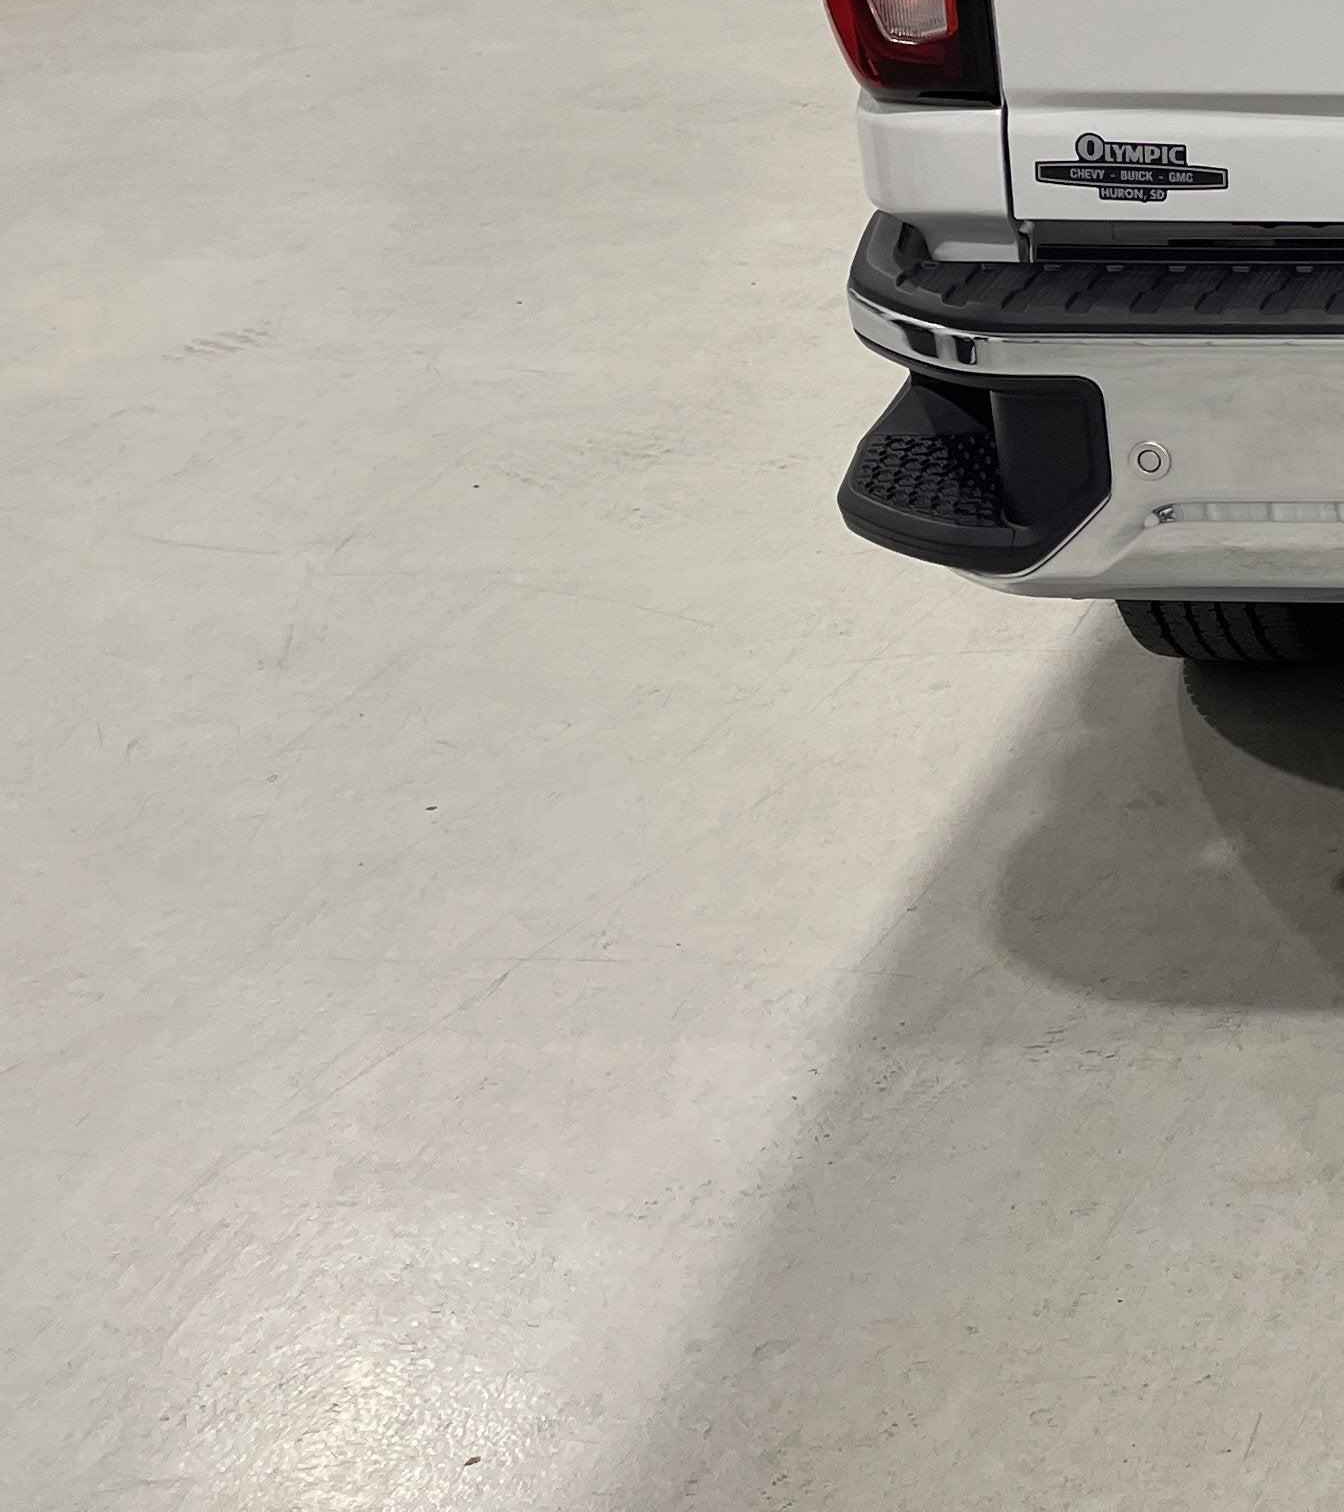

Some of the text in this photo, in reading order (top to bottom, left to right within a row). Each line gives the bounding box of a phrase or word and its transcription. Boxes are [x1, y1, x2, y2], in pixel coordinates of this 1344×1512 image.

[1077, 134, 1186, 165] OLYMPIC
[1069, 168, 1104, 180] CHEVY
[1120, 170, 1153, 181] BUICK
[1168, 171, 1193, 183] GMC
[1101, 188, 1165, 201] HURON, SD
